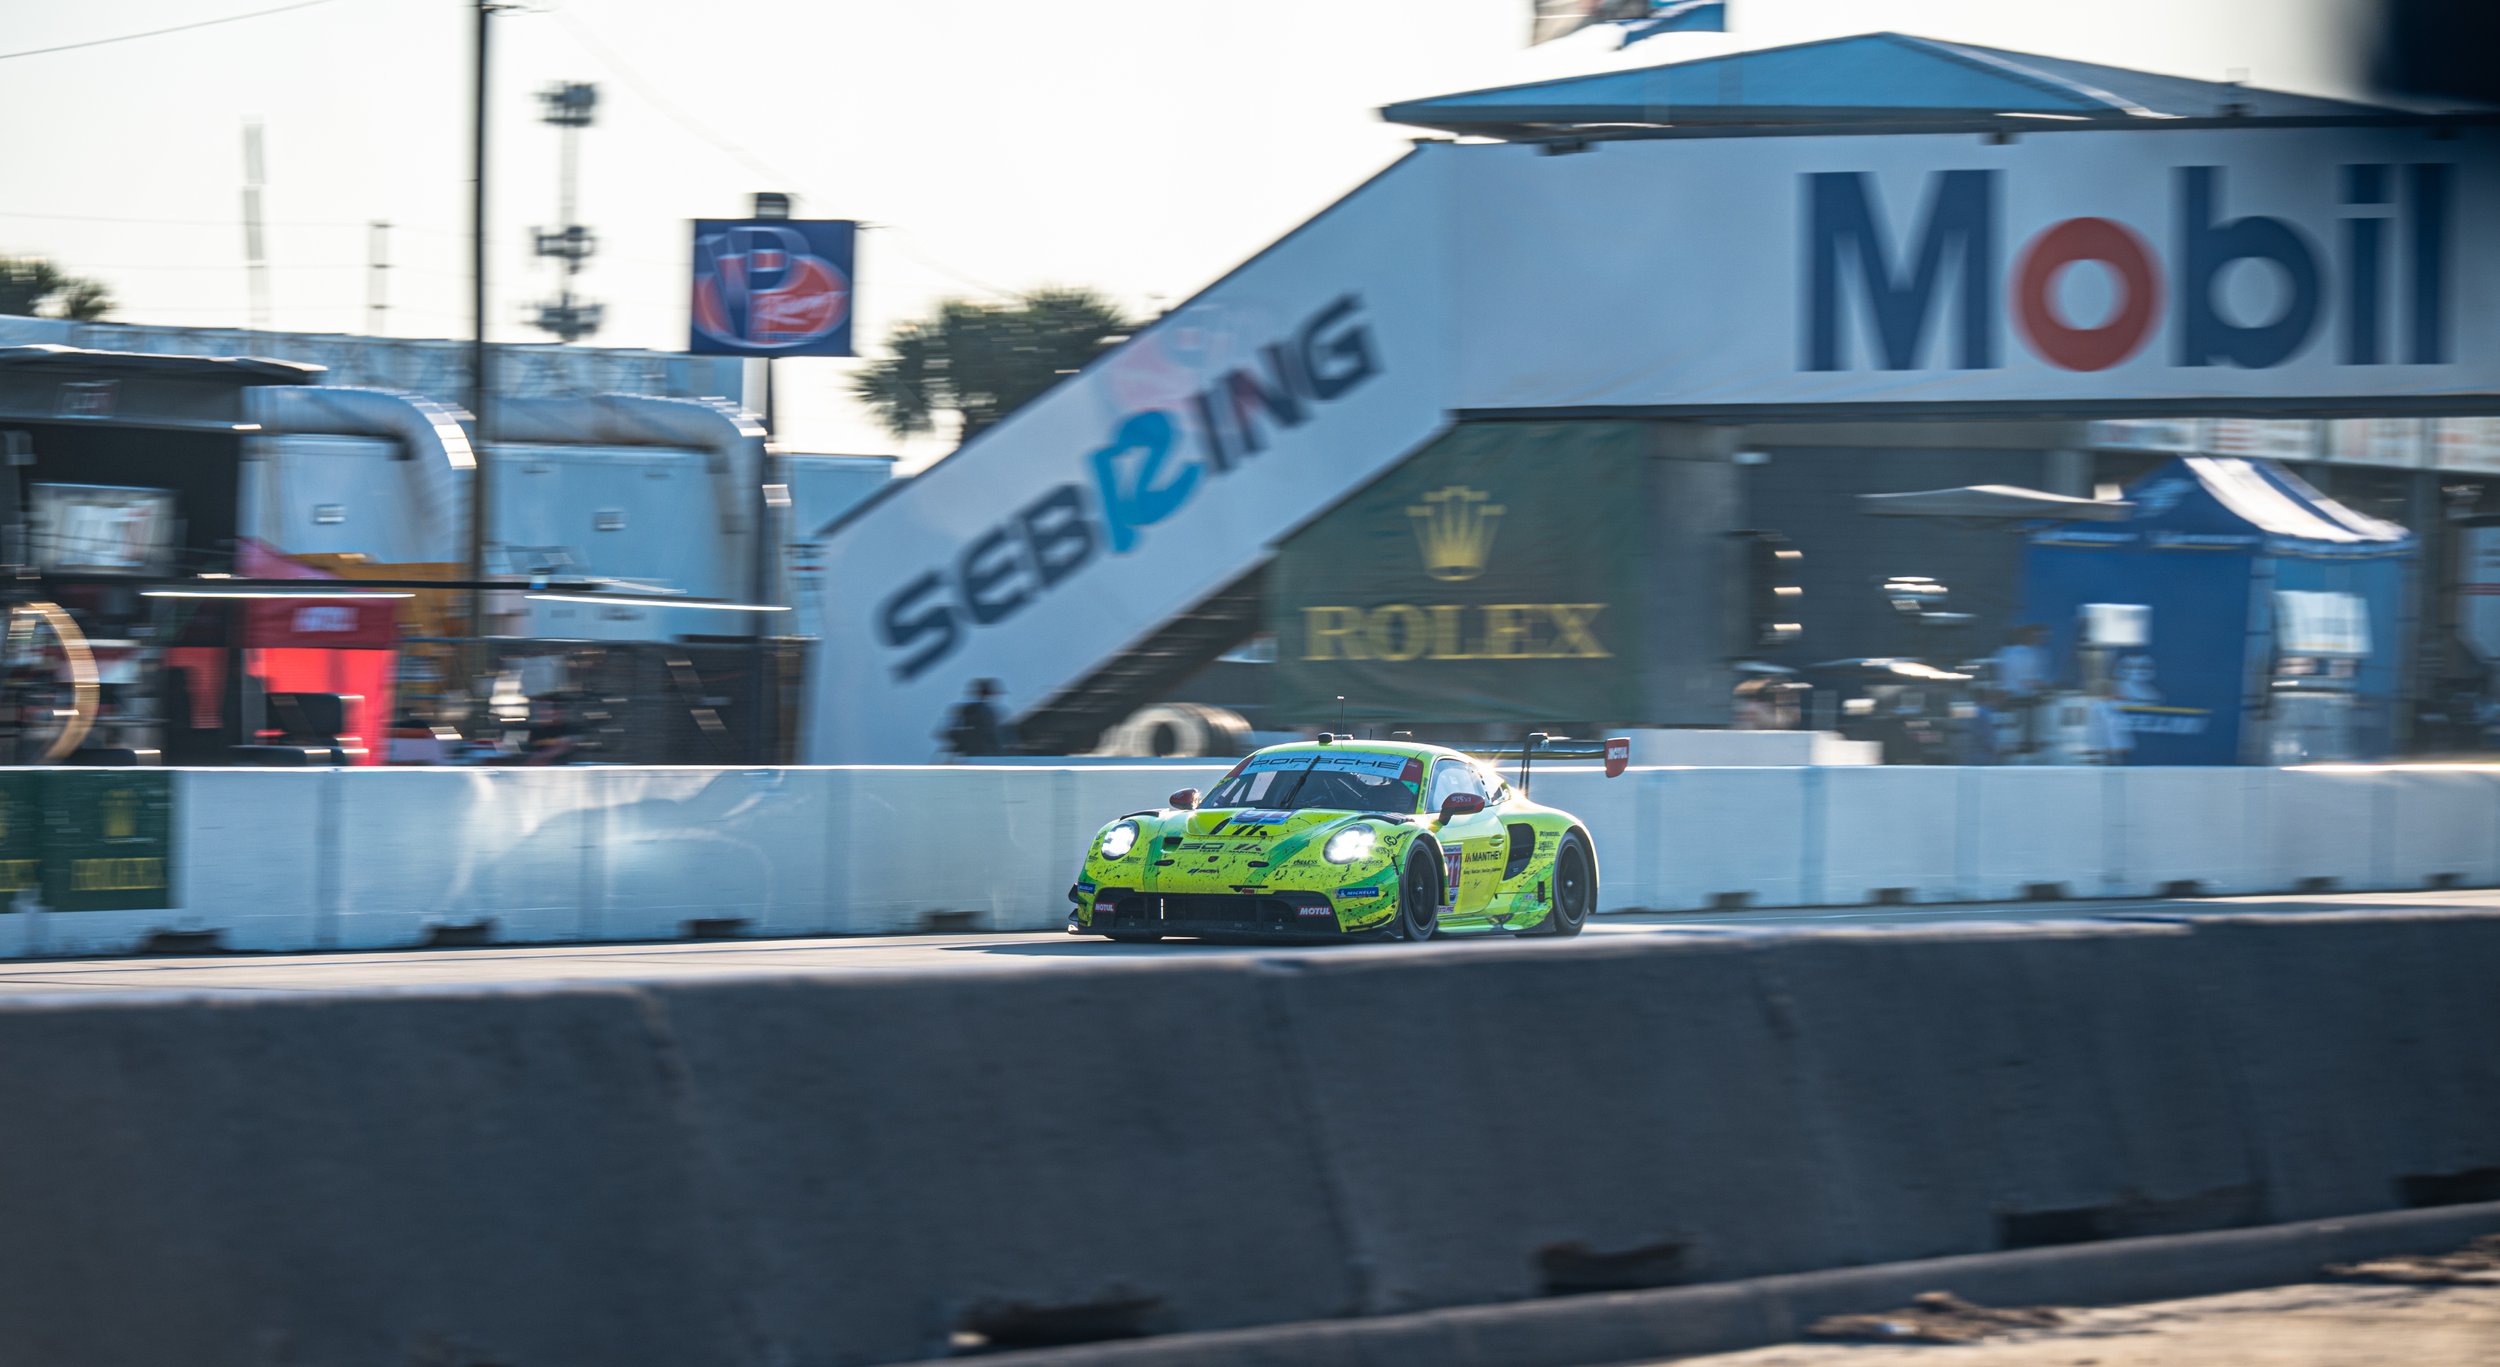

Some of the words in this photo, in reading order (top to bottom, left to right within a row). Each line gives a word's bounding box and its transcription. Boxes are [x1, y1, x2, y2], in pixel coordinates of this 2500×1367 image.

[1796, 163, 2456, 372] Mobil
[873, 294, 1382, 682] SEBRING
[1299, 603, 1613, 661] ROLEX
[1249, 757, 1401, 770] PORSCHE
[1472, 850, 1503, 862] MANTHEY
[1299, 907, 1331, 915] MOTUL
